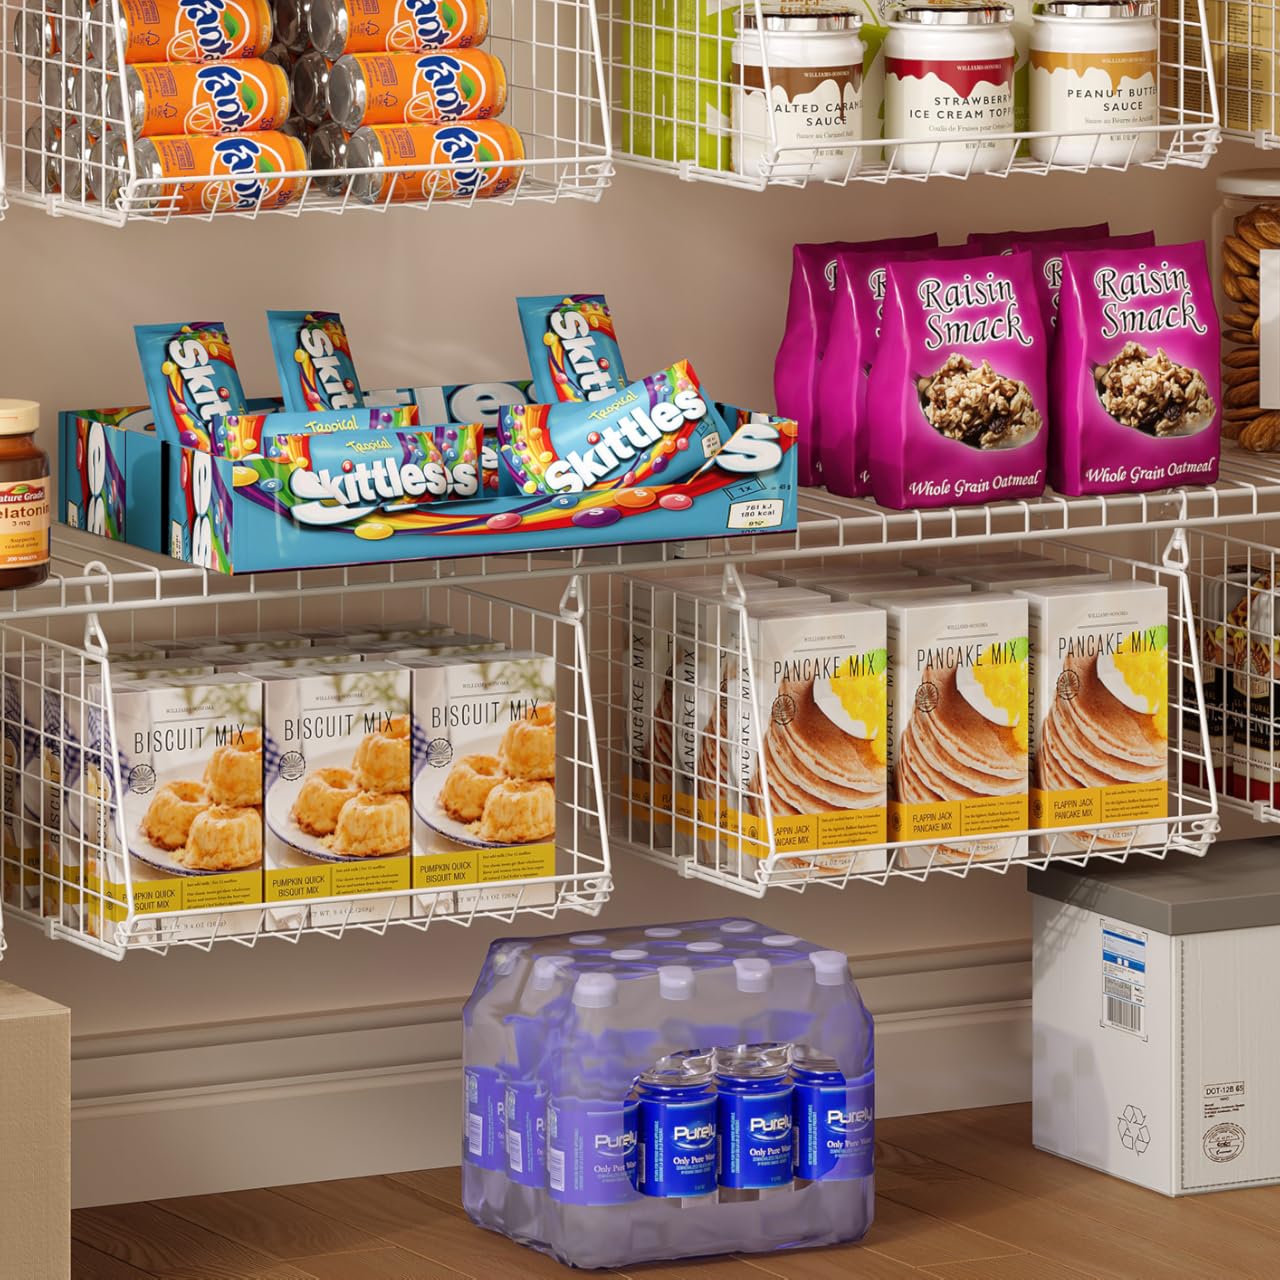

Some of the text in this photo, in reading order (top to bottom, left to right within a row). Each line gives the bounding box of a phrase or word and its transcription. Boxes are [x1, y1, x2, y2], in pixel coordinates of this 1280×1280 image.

[1068, 89, 1123, 99] PEANUT
[806, 116, 847, 126] SAUCE
[937, 109, 983, 120] CREAM
[918, 273, 1015, 314] Raisin
[1094, 262, 1190, 303] Raisin
[925, 302, 1034, 350] Smack
[1101, 289, 1208, 339] Smack
[587, 390, 639, 421] Tropical
[544, 390, 707, 496] Skittles
[909, 470, 1042, 497] Whole Grain Oatmeal
[917, 642, 1018, 672] PANCAKE MIX
[1058, 630, 1157, 660] PANCAKE MIX
[284, 711, 394, 741] BISCUIT MIX
[431, 698, 540, 729] BISCUIT MIX
[420, 860, 472, 873] PUMPKIN QUICK
[750, 1117, 792, 1134] Purely
